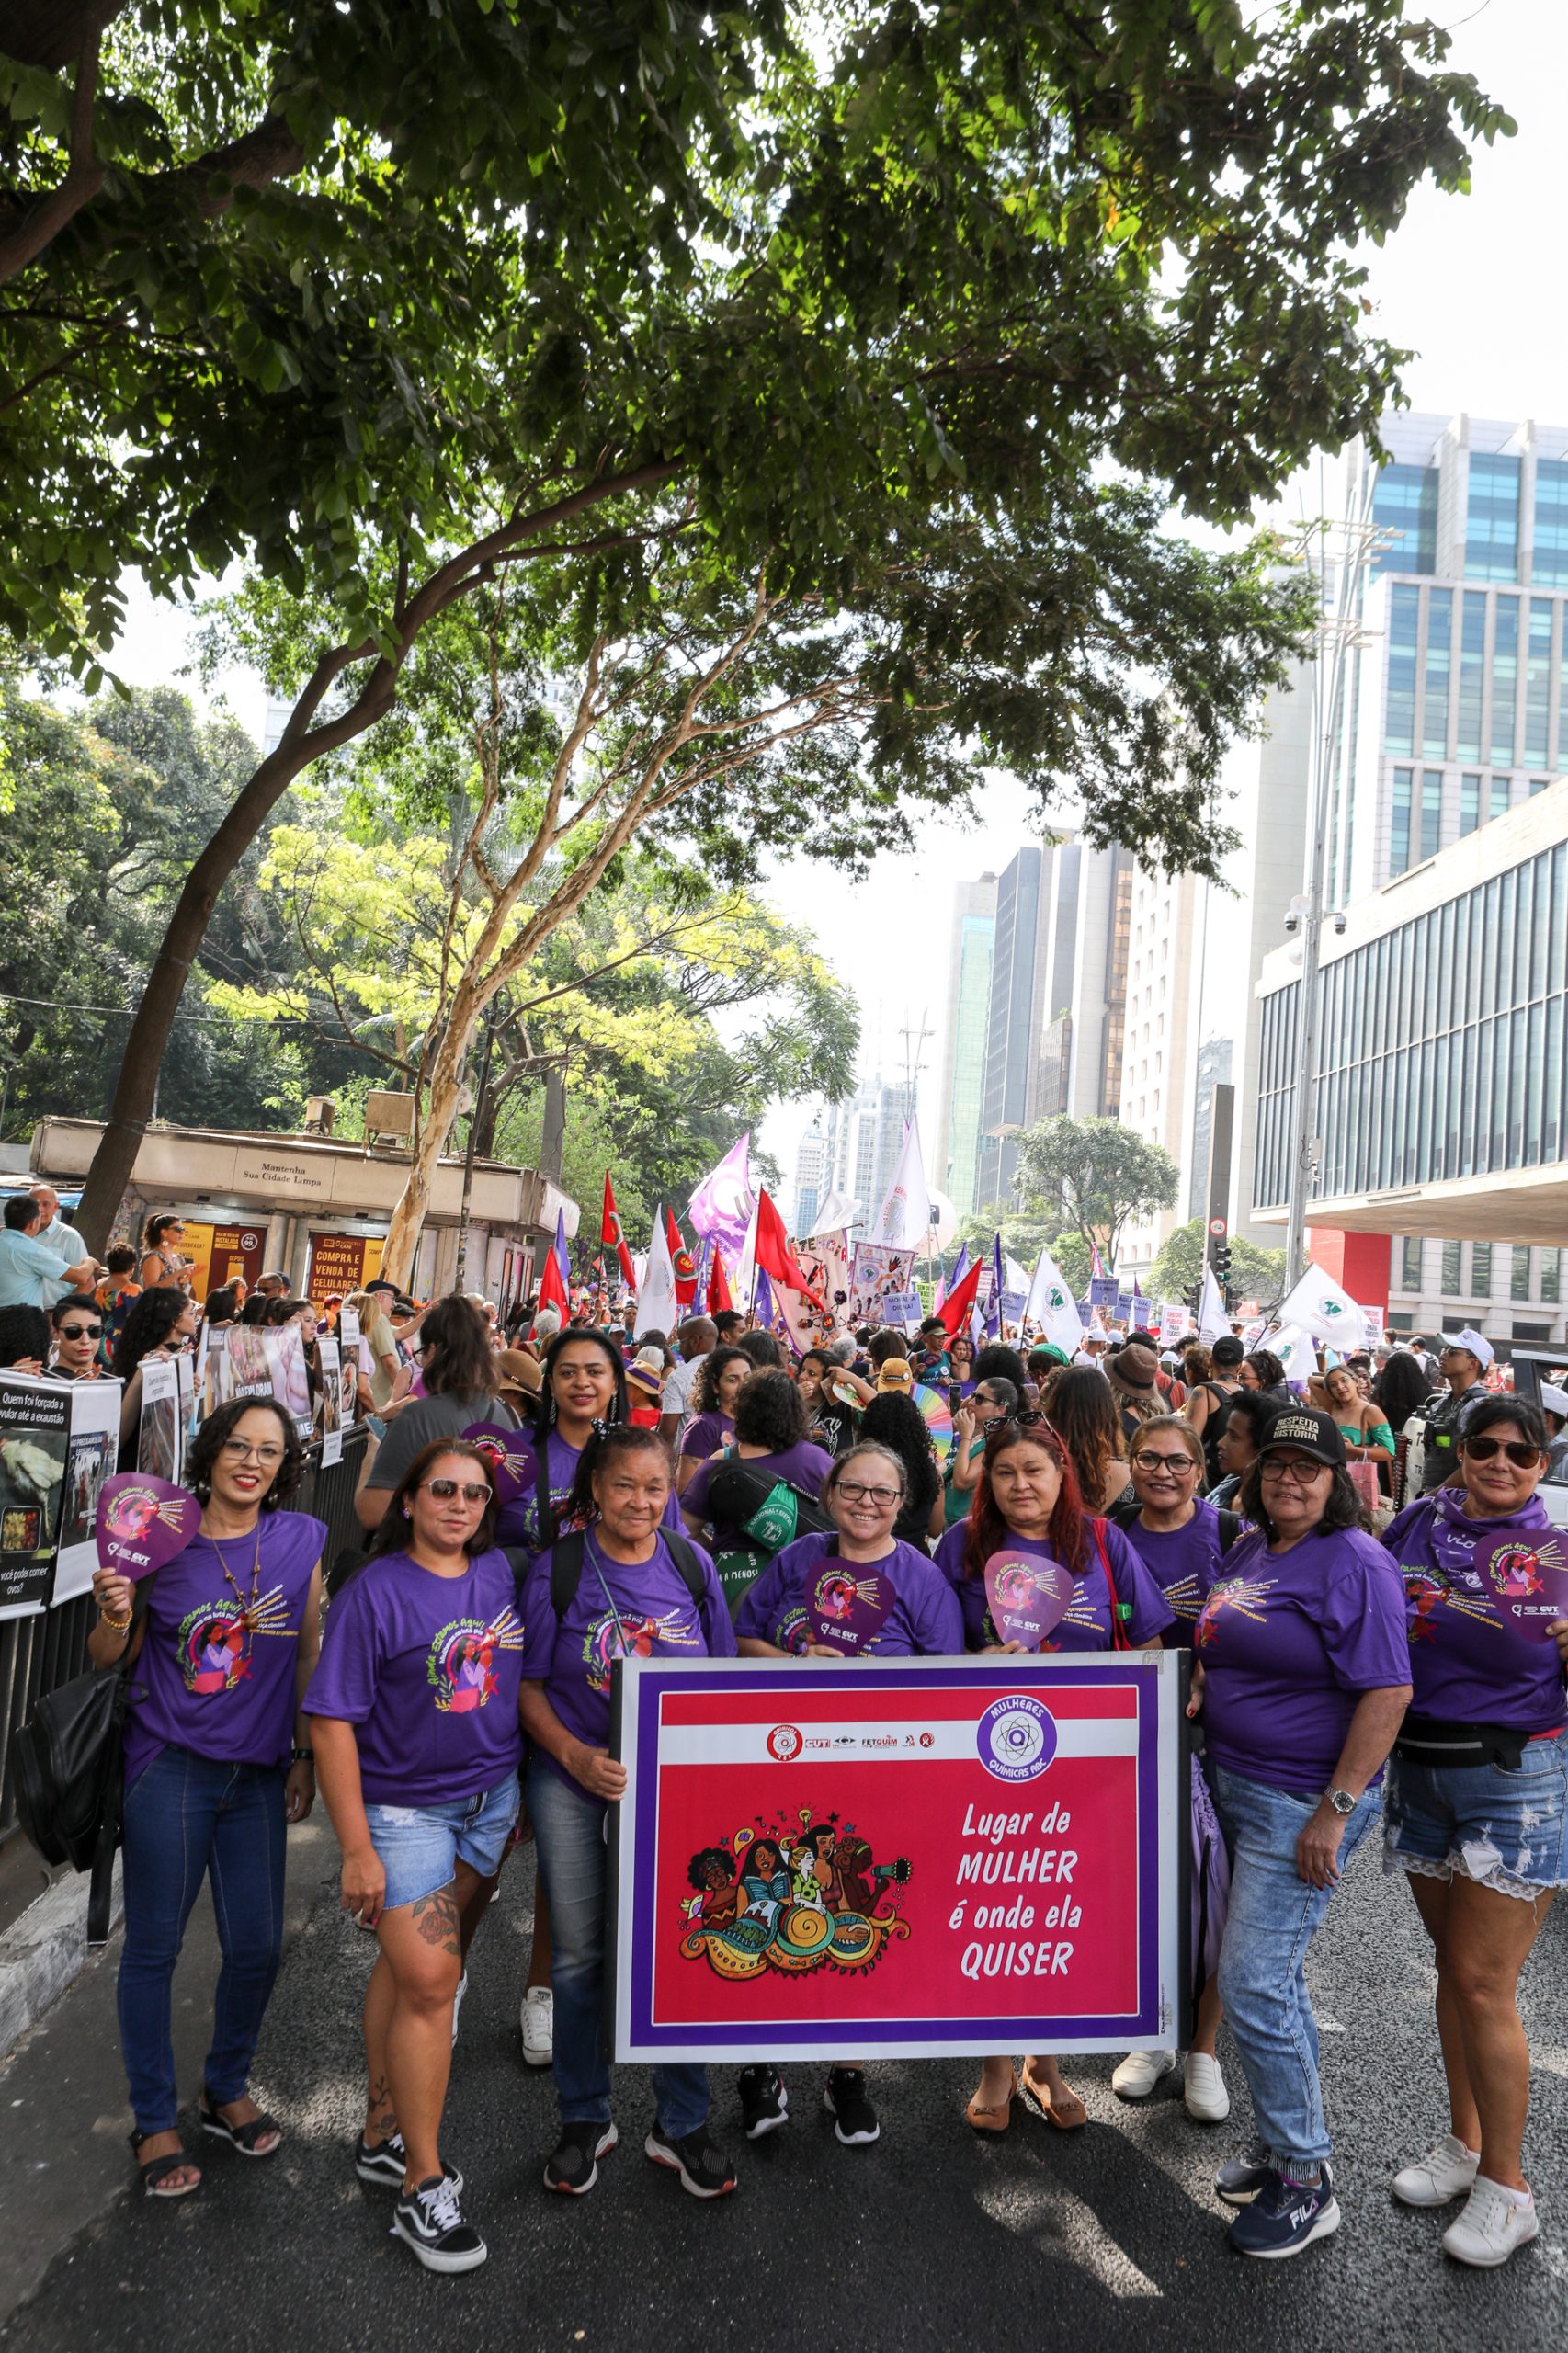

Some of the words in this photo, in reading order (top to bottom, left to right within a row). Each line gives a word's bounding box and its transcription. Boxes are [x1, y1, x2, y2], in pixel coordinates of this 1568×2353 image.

[261, 1163, 306, 1175] Mantenha
[244, 1170, 258, 1179] Sua
[262, 1172, 291, 1183] Cidade
[294, 1176, 321, 1187] Limpa
[316, 1250, 352, 1263] COMPRA
[354, 1254, 360, 1264] E
[315, 1264, 344, 1277] VENDA
[347, 1267, 358, 1278] DE
[312, 1289, 317, 1298] E
[3, 1392, 23, 1405] Quem
[25, 1394, 34, 1406] foi
[35, 1395, 59, 1410] forçada
[59, 1401, 64, 1410] a
[0, 1408, 17, 1420] vular
[18, 1409, 30, 1422] até
[30, 1413, 35, 1421] a
[36, 1413, 64, 1424] exaustão
[1277, 1415, 1319, 1429] RESPEITA
[1446, 1533, 1476, 1549] vio
[1, 1569, 13, 1581] você
[14, 1567, 28, 1582] poder
[29, 1567, 49, 1578] comer
[7, 1582, 24, 1595] ovos?
[990, 1699, 1044, 1719] MULHERES
[862, 1736, 898, 1746] FETQUIM
[989, 1759, 1029, 1778] QUÍMICAS
[1030, 1757, 1047, 1774] ABC
[961, 1803, 1034, 1845] Lugar
[1040, 1801, 1071, 1835] de
[956, 1847, 1078, 1885] MULHER
[949, 1899, 968, 1930] é
[973, 1894, 1035, 1930] onde
[1044, 1894, 1083, 1928] ela
[960, 1941, 1074, 1981] QUISER
[1290, 2197, 1319, 2230] FILA
